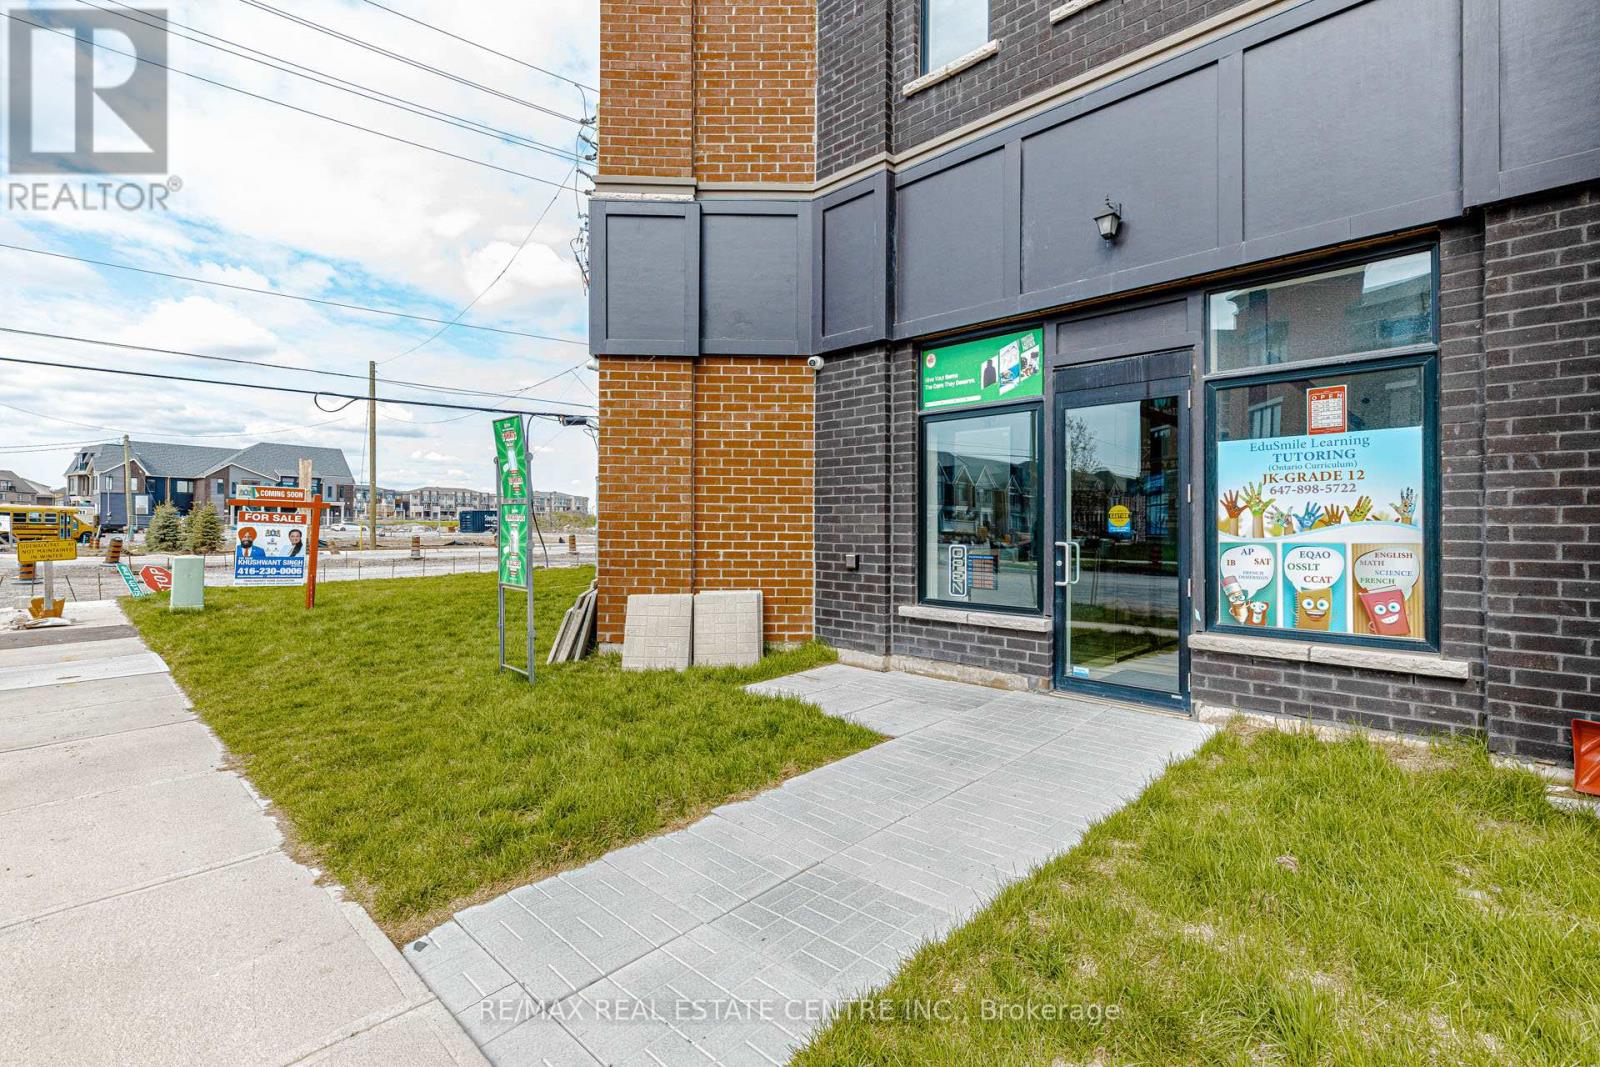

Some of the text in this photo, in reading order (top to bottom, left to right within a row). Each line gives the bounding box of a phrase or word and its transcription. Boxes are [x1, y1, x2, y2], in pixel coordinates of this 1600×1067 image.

[1311, 392, 1342, 401] OPEN
[1250, 436, 1370, 452] EduSmile Learning
[1272, 448, 1356, 463] TUTORING
[1268, 460, 1358, 472] (Ontario Curriculum)
[1262, 470, 1365, 485] JK-GRADE 12
[1269, 483, 1357, 495] 647-898-5722
[260, 490, 285, 498] COMING
[244, 513, 302, 523] FOR SALE
[1241, 548, 1255, 556] AP
[1299, 550, 1331, 560] EQAO
[1374, 551, 1413, 559] ENGLISH
[1254, 557, 1271, 566] SAT
[237, 567, 303, 575] 416-230-0006
[1287, 562, 1320, 571] OSSLT
[1375, 569, 1413, 577] SCIENCE
[149, 567, 173, 591] TOP
[1303, 575, 1333, 584] CCAT
